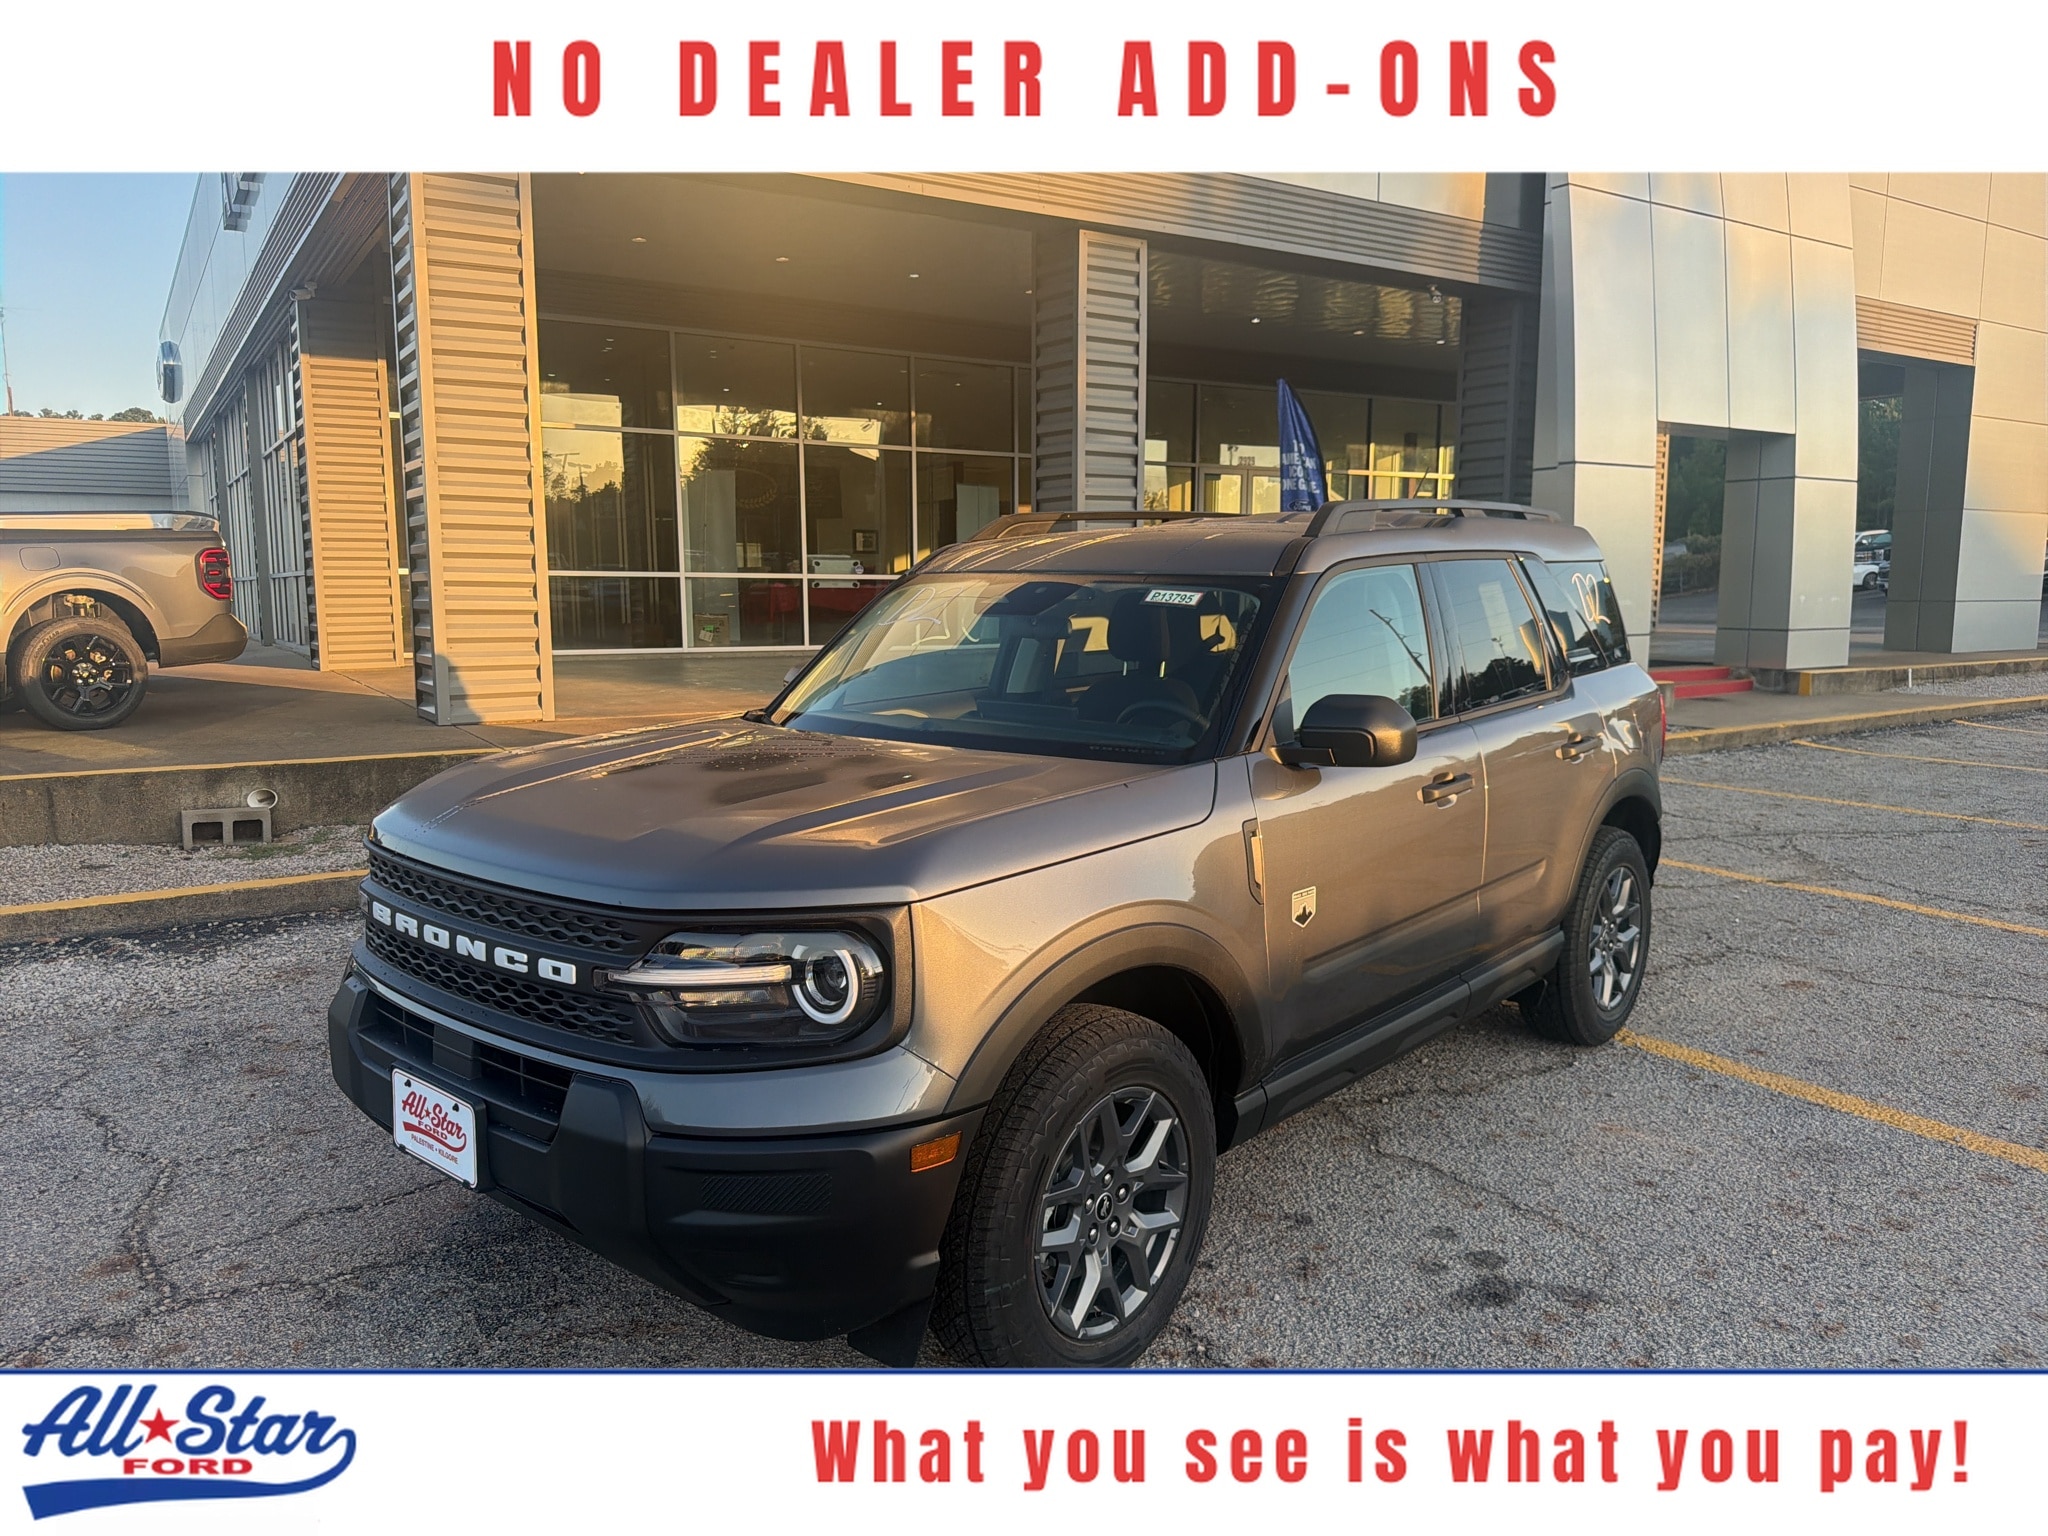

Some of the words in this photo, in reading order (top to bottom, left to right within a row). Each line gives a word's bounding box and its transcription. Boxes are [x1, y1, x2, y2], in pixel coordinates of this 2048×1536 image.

[1150, 591, 1195, 604] P13795
[372, 901, 577, 985] BRONCO
[401, 1090, 428, 1121] All
[430, 1102, 465, 1140] Star
[417, 1119, 448, 1141] FORD
[410, 1133, 435, 1152] PALESTINE
